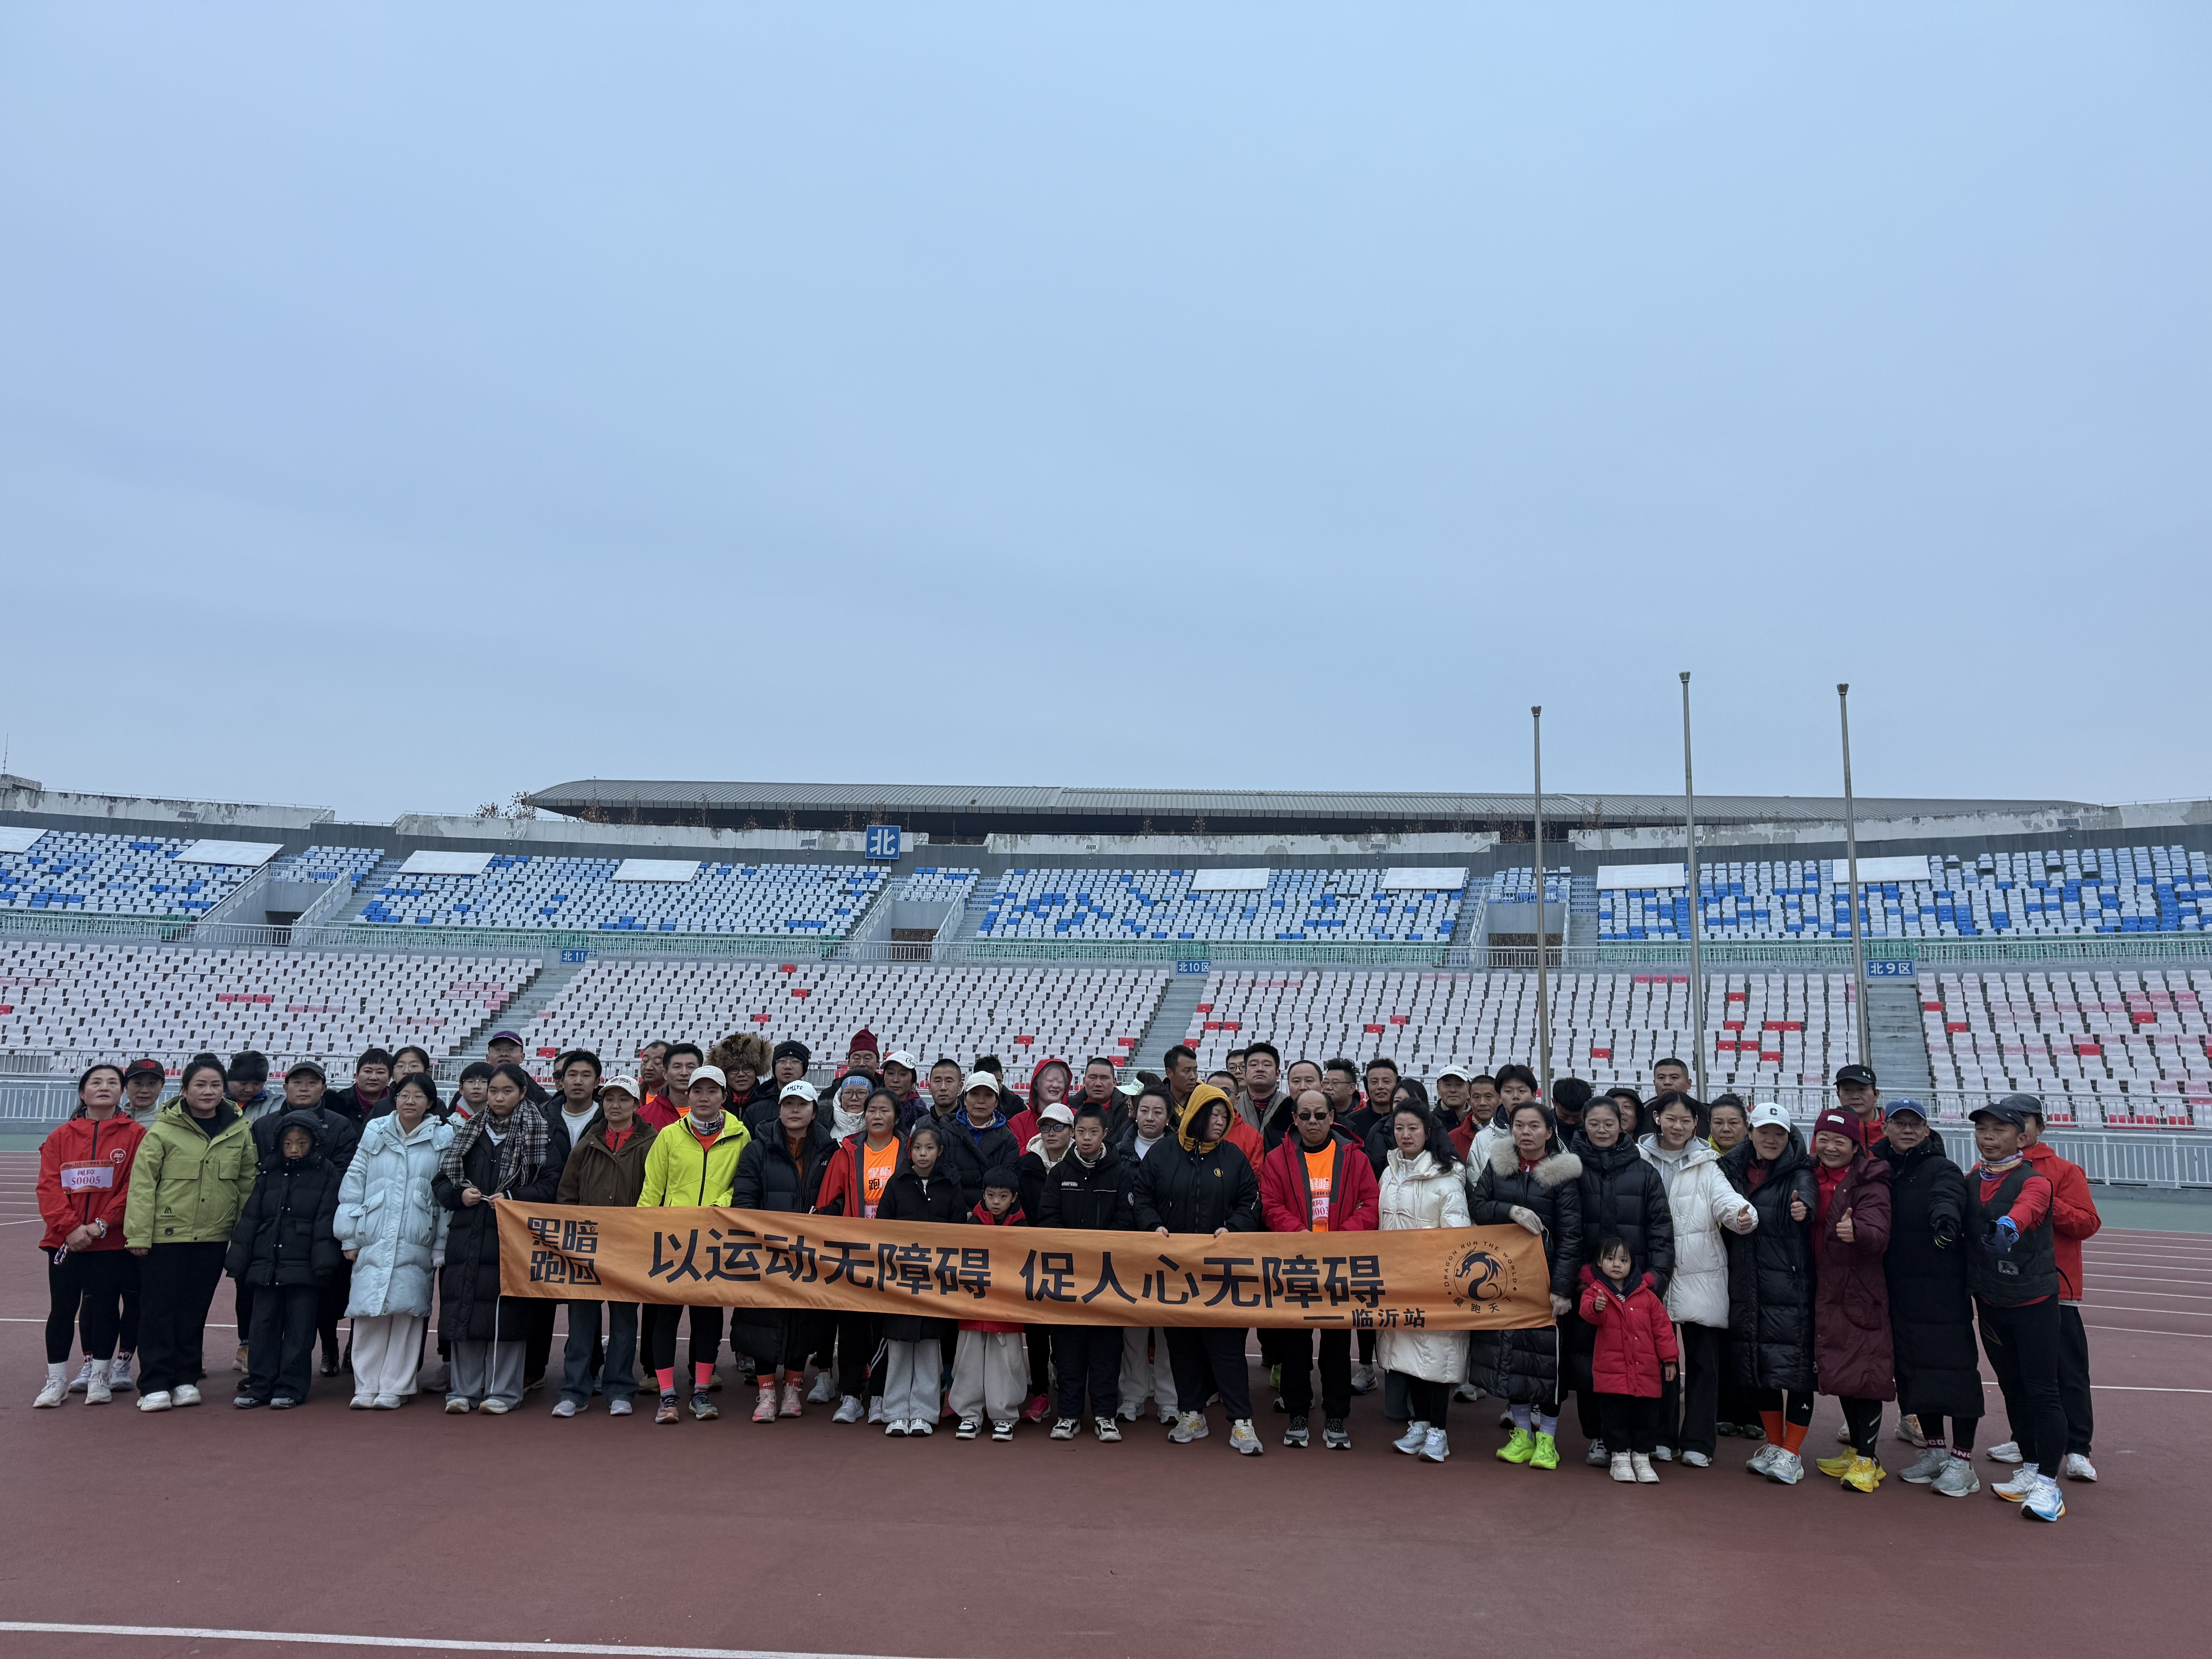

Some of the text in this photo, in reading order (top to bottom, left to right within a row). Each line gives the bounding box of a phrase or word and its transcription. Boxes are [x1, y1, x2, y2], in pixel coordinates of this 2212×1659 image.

[869, 829, 896, 855] 北
[1871, 963, 1911, 974] 北9区
[71, 1176, 101, 1185] S0005
[527, 1217, 598, 1254] 黑暗
[530, 1250, 601, 1285] 跑团
[648, 1228, 1386, 1308] 以运动无障碍 促人心无障碍
[1444, 1241, 1517, 1287] DRAGON RUN THE WORLD
